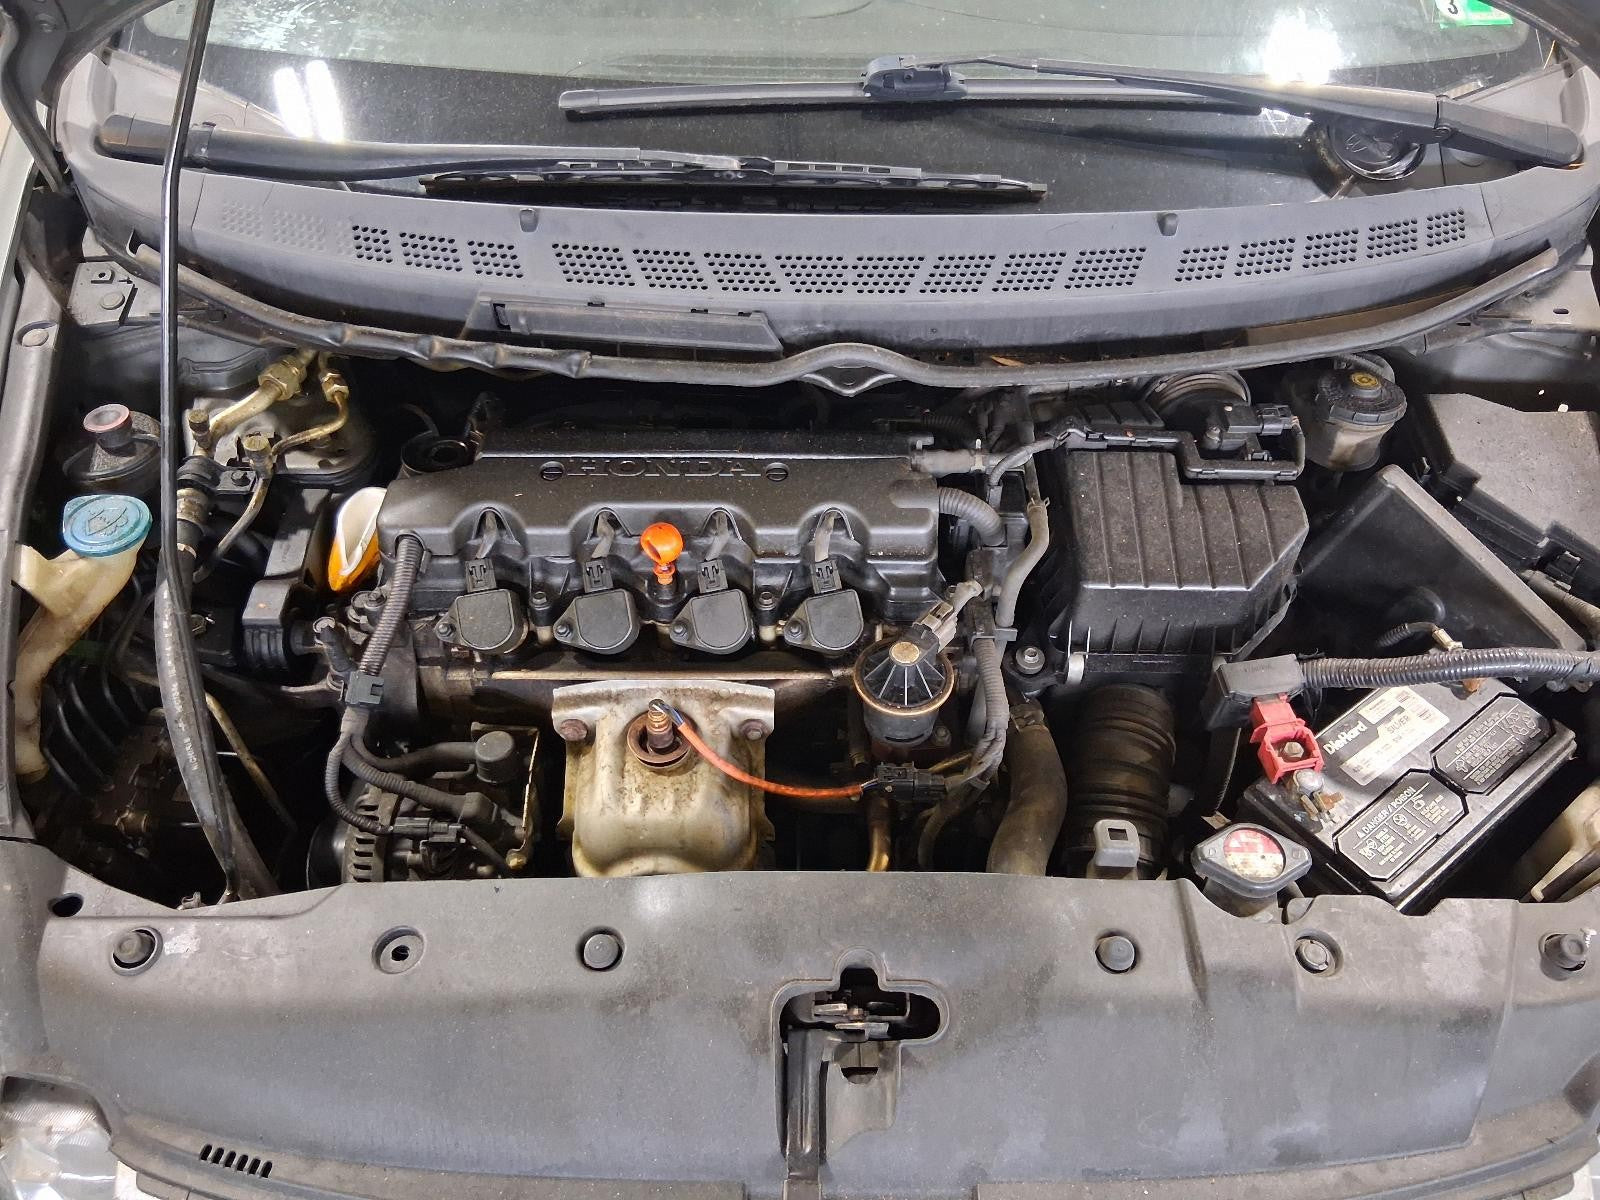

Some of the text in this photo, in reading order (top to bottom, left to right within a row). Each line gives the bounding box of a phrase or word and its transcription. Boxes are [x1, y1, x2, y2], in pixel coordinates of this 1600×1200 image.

[567, 459, 762, 477] HONDA
[1386, 714, 1410, 735] SILVER
[1323, 720, 1368, 755] DieHard
